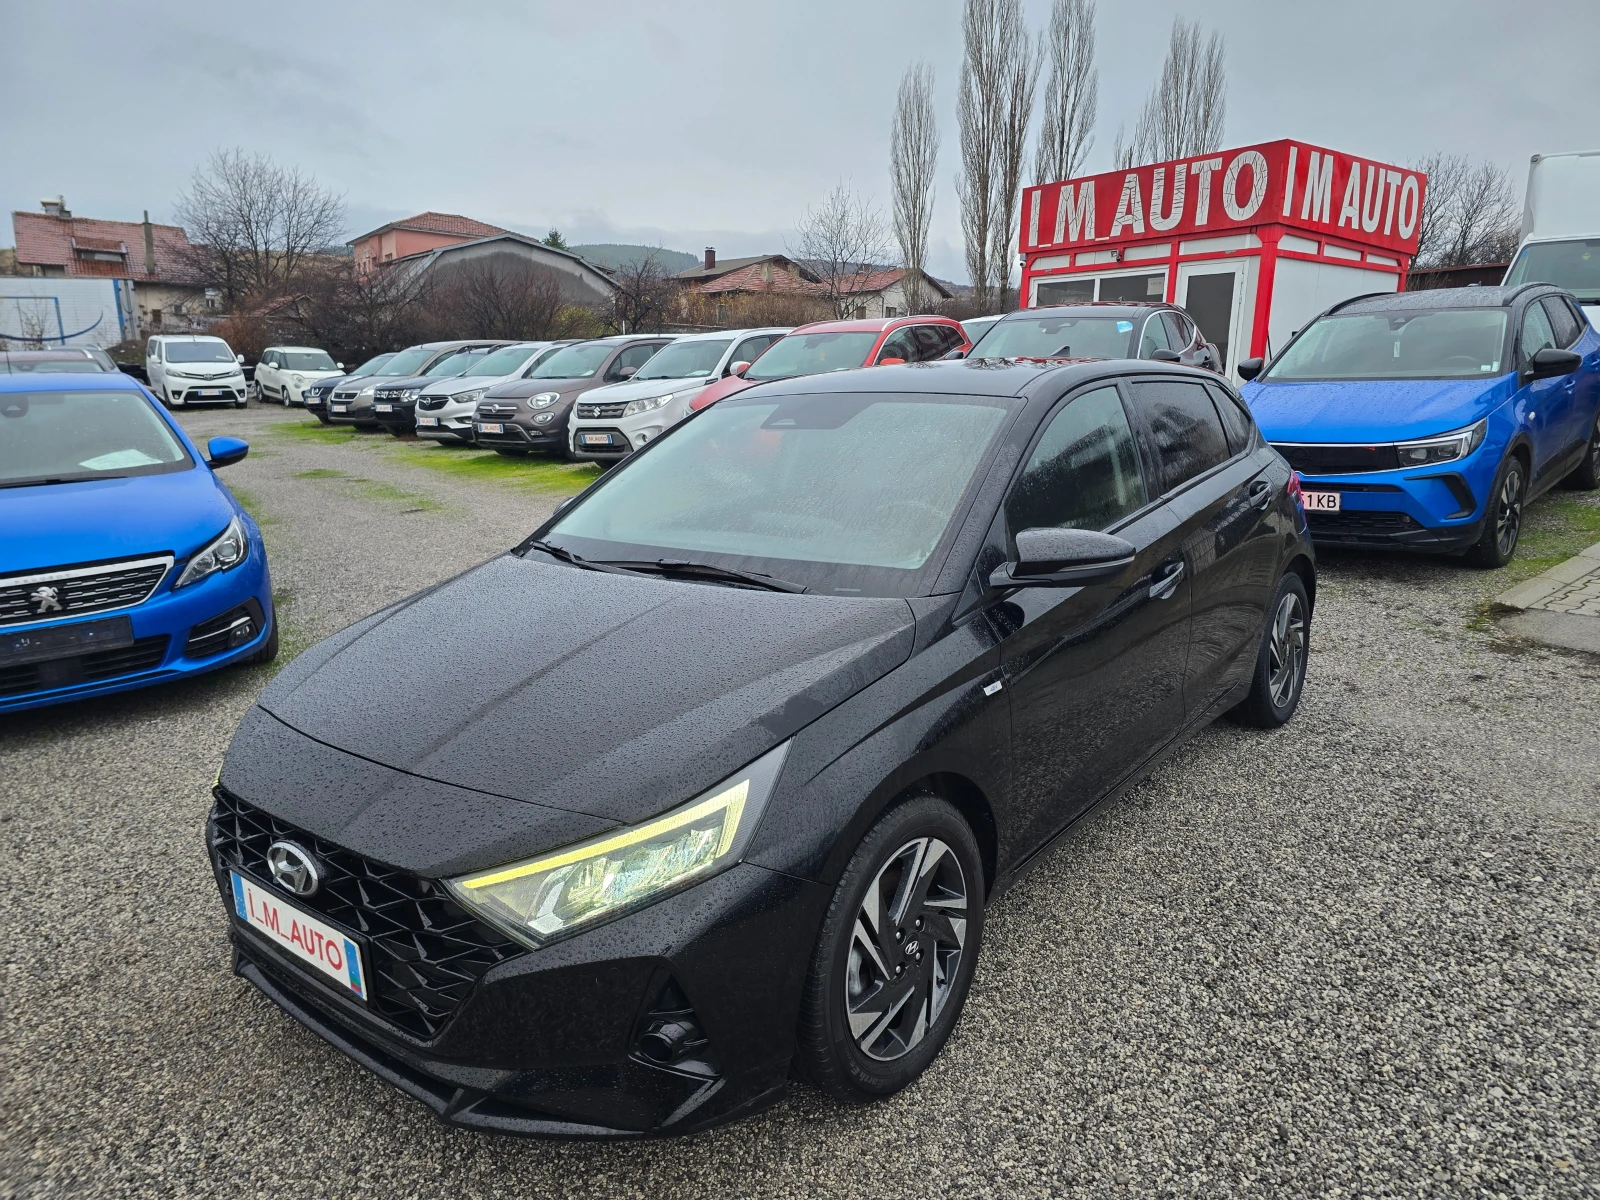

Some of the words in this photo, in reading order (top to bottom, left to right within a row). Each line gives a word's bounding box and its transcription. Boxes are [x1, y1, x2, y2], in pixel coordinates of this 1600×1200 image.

[1282, 146, 1297, 217] I
[1301, 151, 1333, 224] M
[1338, 161, 1419, 239] AUTO
